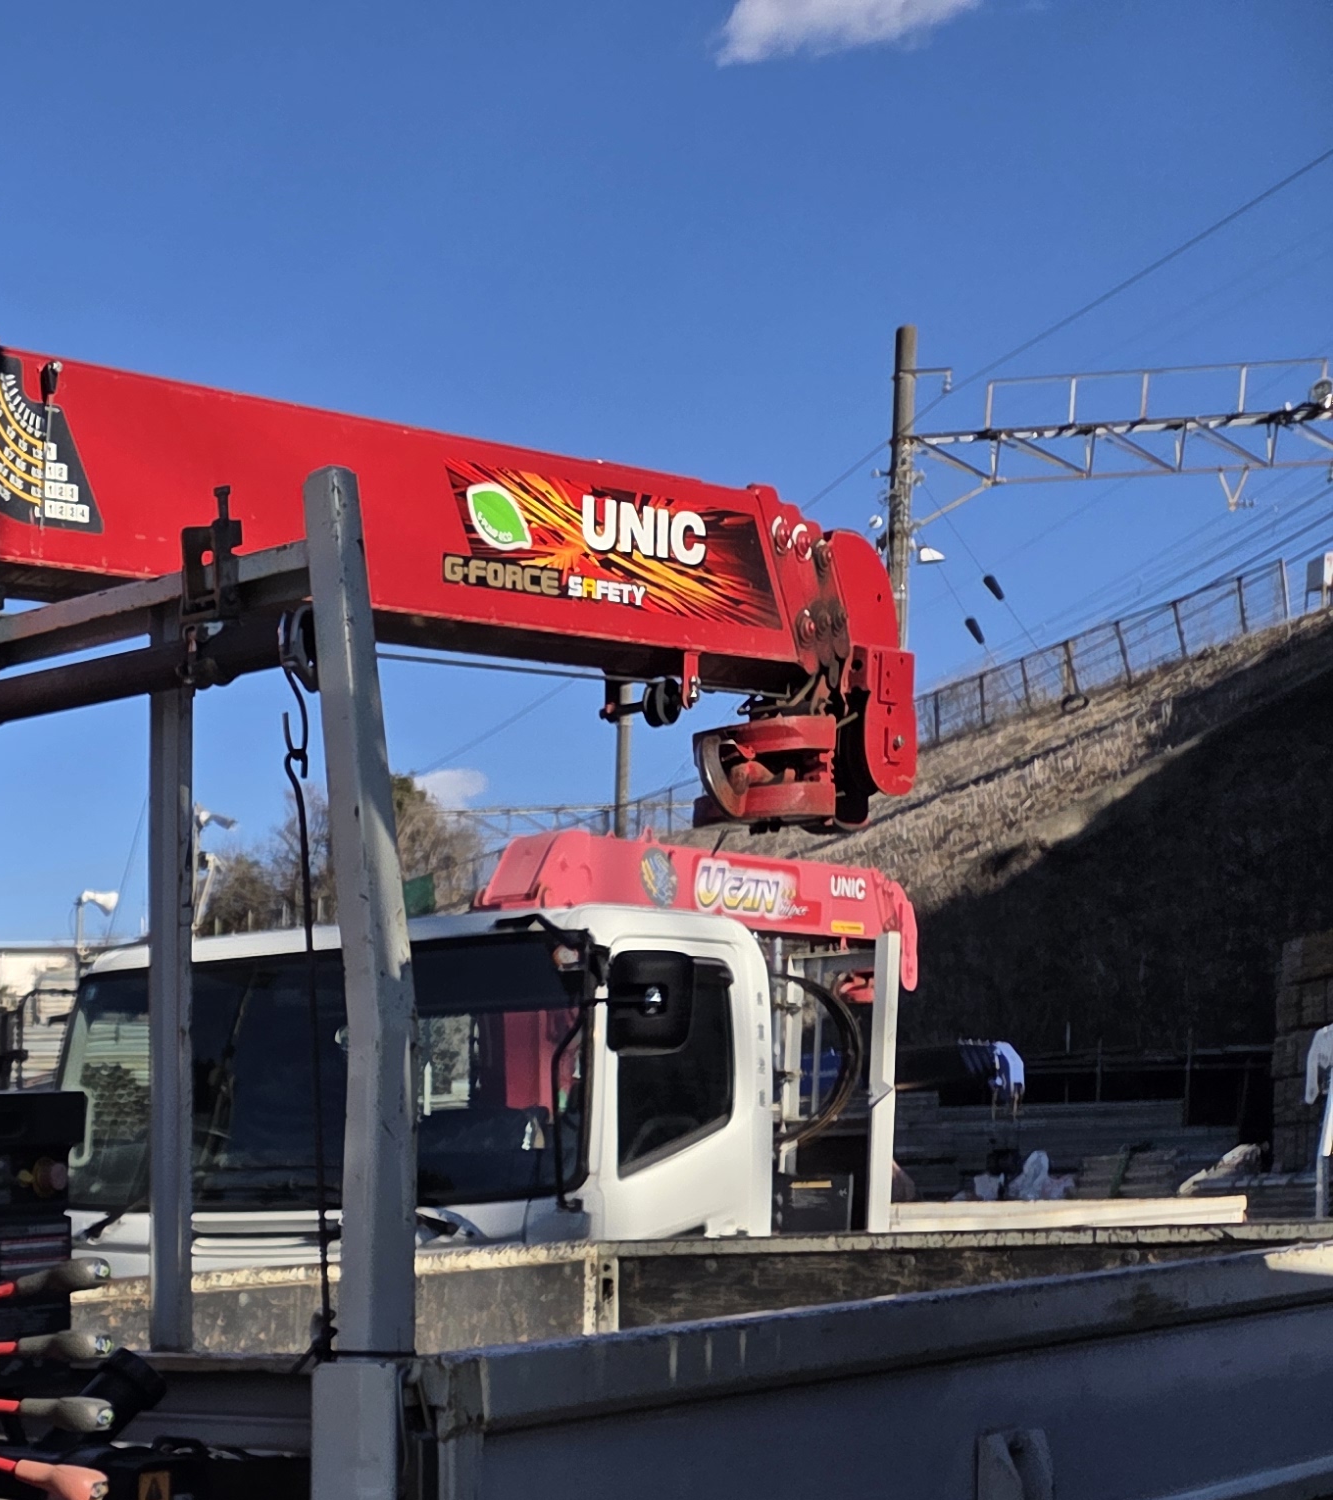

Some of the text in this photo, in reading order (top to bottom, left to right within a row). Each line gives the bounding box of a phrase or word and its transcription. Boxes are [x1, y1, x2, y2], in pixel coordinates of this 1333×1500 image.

[582, 494, 707, 566] UNIC
[444, 555, 647, 606] G-FORCE SAFETY
[830, 874, 866, 900] UNIC
